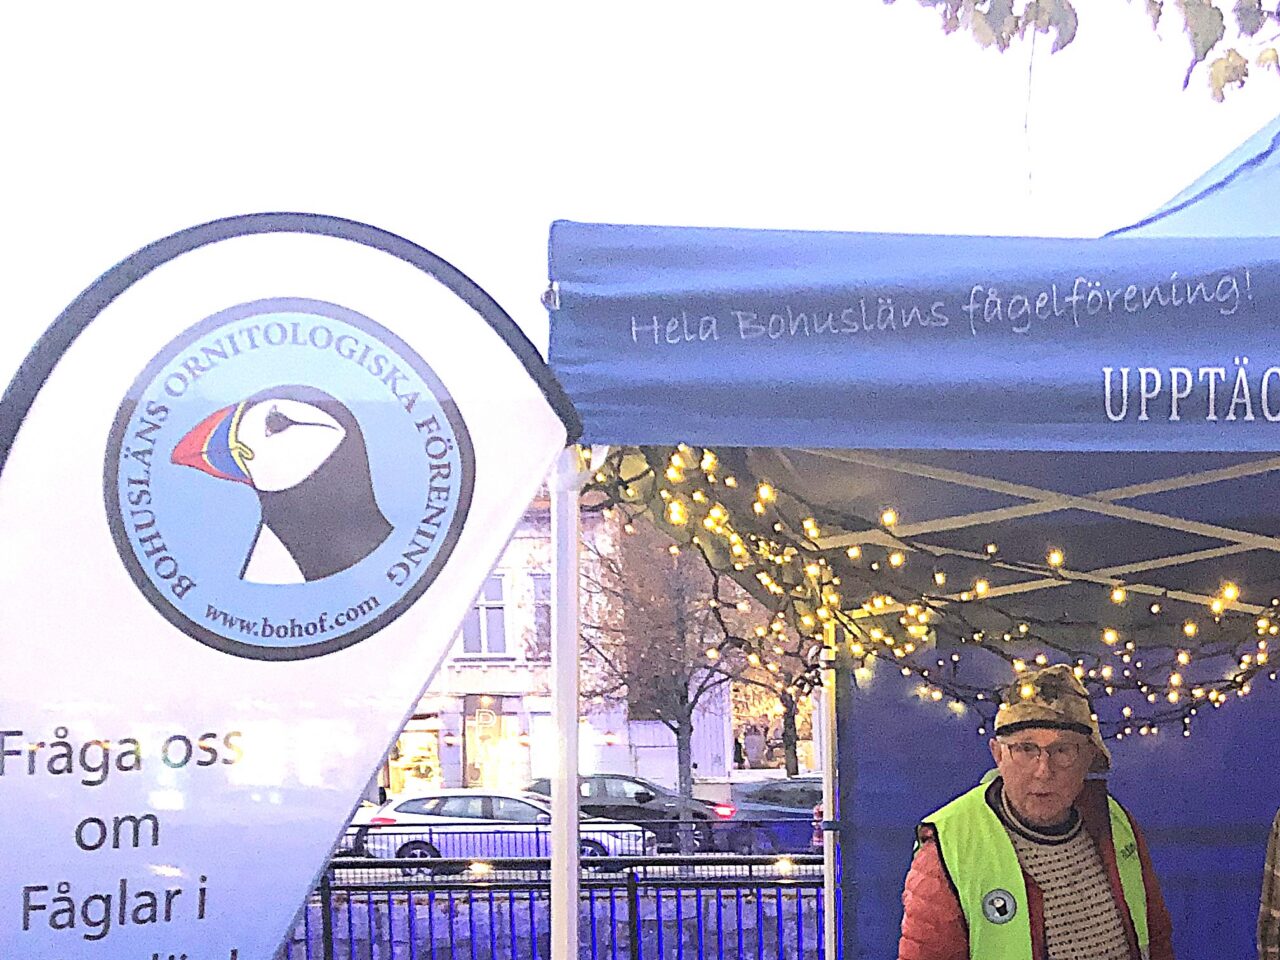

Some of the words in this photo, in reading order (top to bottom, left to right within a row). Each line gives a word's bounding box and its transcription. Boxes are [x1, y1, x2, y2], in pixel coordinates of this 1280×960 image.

[631, 311, 719, 345] Hela
[731, 297, 950, 340] Bohusläns
[961, 270, 1253, 336] fågelförening!
[122, 402, 197, 601] BOHUSLÄNS
[165, 321, 422, 414] ORNITOLOGISKA
[386, 417, 454, 589] FÖRENING
[203, 593, 381, 640] www.bohof.com
[0, 727, 142, 786] Fråga
[162, 728, 243, 770] oss
[76, 812, 160, 850] om
[22, 878, 183, 941] Fåglar
[197, 877, 208, 920] i
